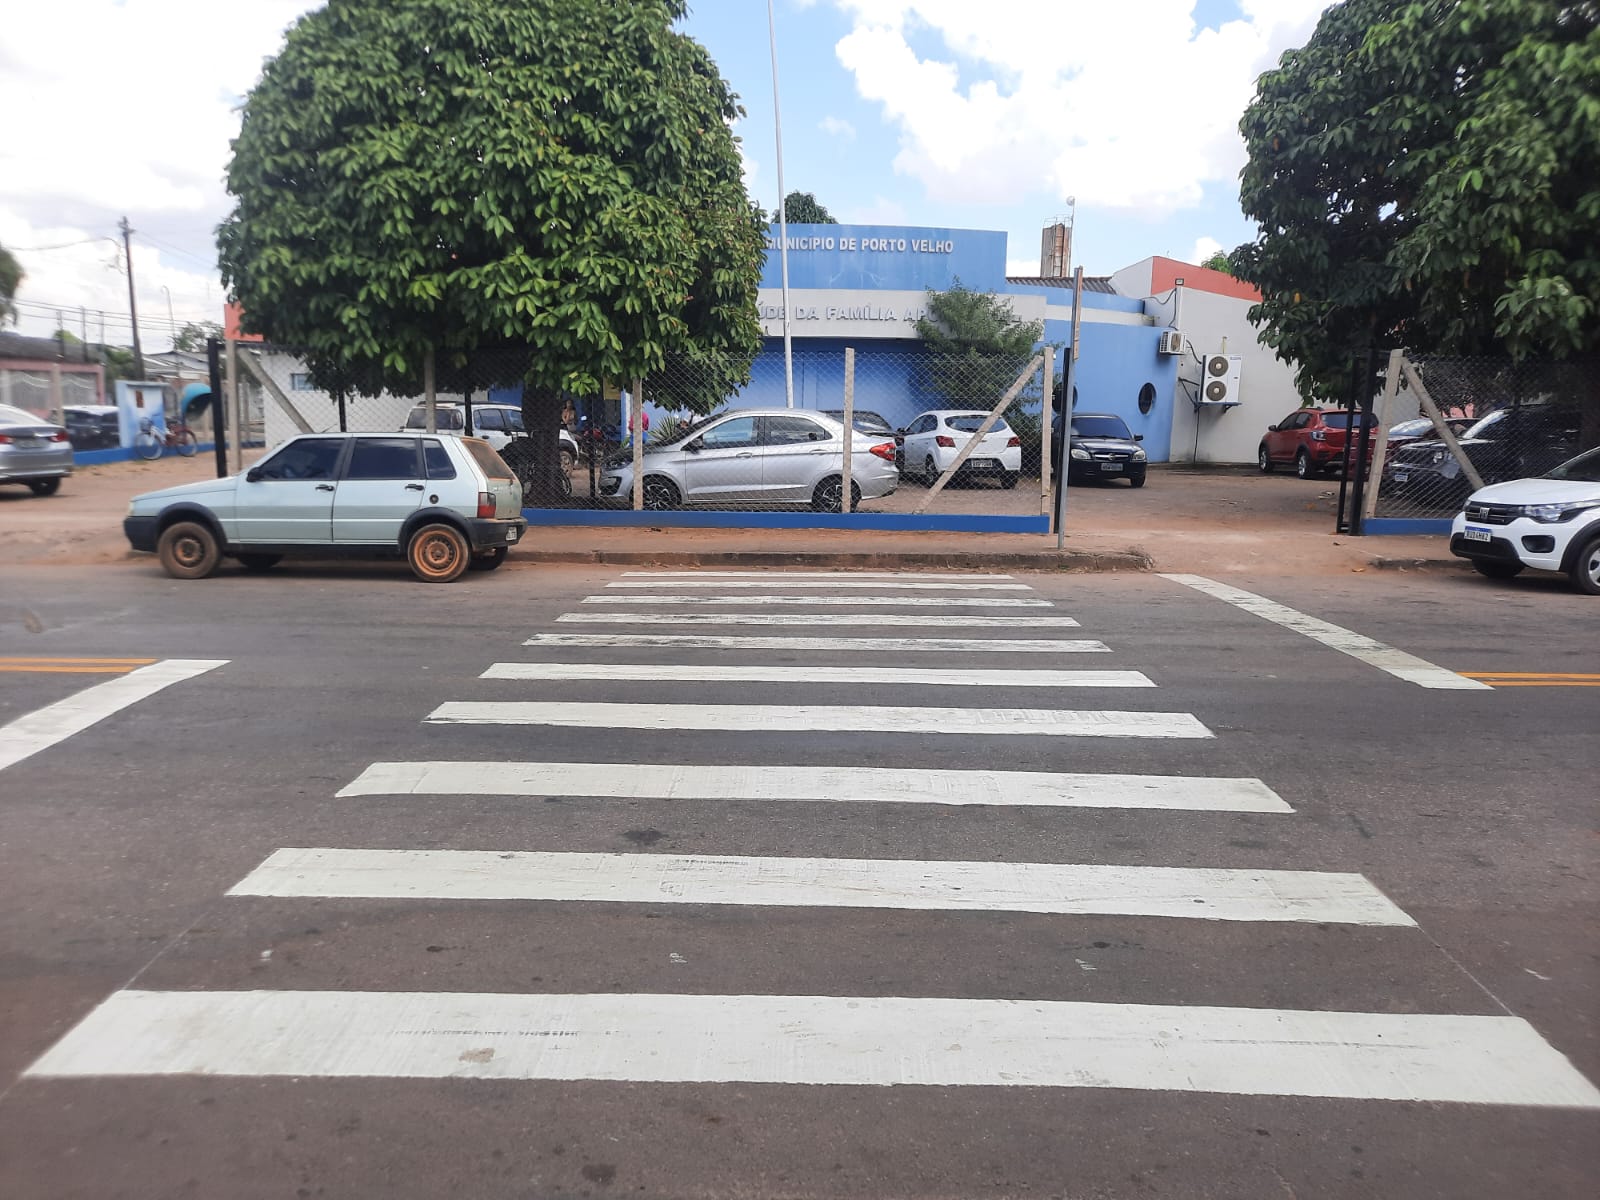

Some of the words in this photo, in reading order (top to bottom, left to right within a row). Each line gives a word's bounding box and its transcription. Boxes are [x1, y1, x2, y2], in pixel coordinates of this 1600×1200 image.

[839, 237, 857, 251] DE
[861, 237, 906, 252] PORTO
[912, 239, 954, 253] VELHO
[795, 304, 819, 320] DA
[825, 302, 897, 321] FAMÍLIA
